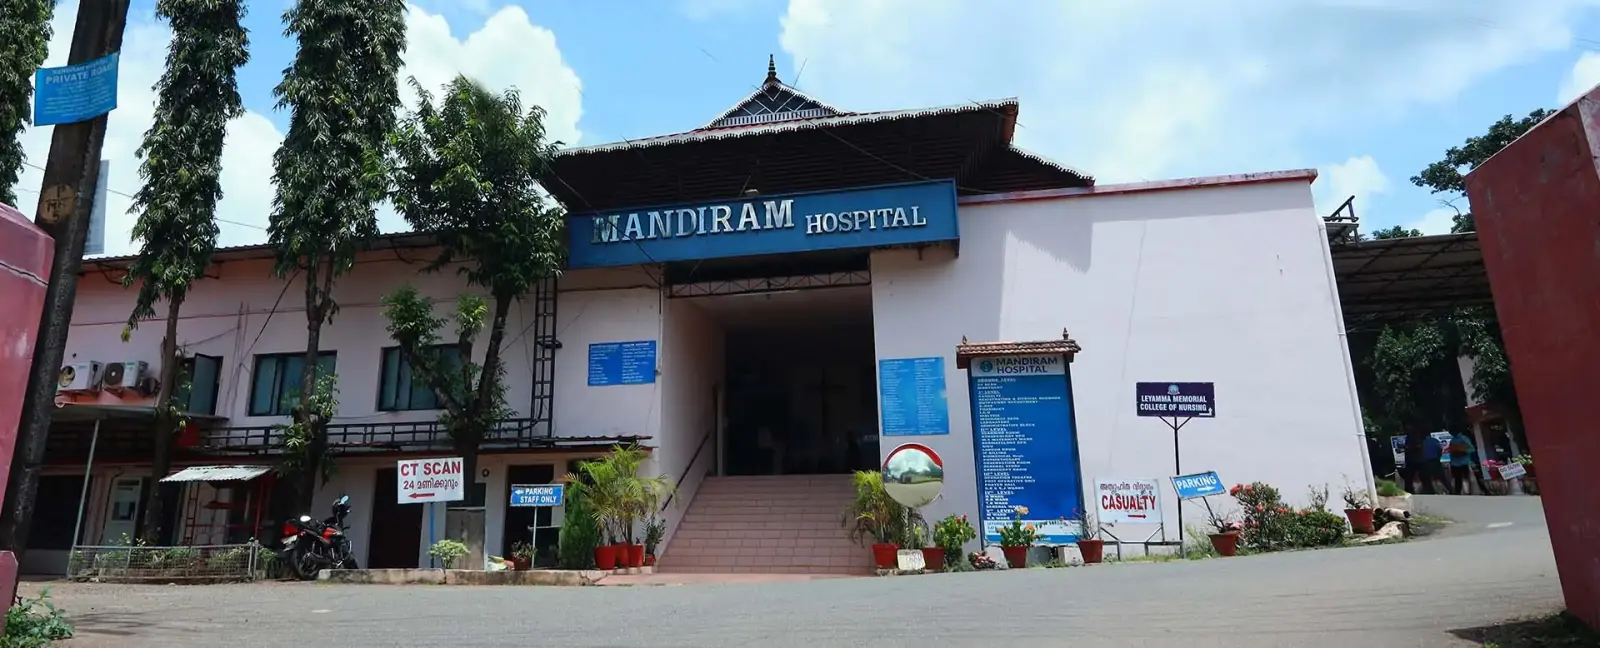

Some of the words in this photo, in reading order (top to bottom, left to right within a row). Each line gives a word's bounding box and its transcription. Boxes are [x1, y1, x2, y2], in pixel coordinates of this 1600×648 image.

[46, 71, 88, 84] PRIVATE
[90, 64, 113, 77] ROAD
[590, 200, 795, 244] MANDIRAM
[806, 206, 927, 235] HOSPITAL
[996, 356, 1058, 366] MANDIRAM
[996, 365, 1048, 374] HOSPITAL
[400, 463, 419, 477] CT
[423, 460, 461, 475] SCAN
[403, 481, 414, 490] 24
[1176, 475, 1217, 489] PARKING
[525, 487, 553, 495] PARKING
[1102, 495, 1156, 510] CASUALTY
